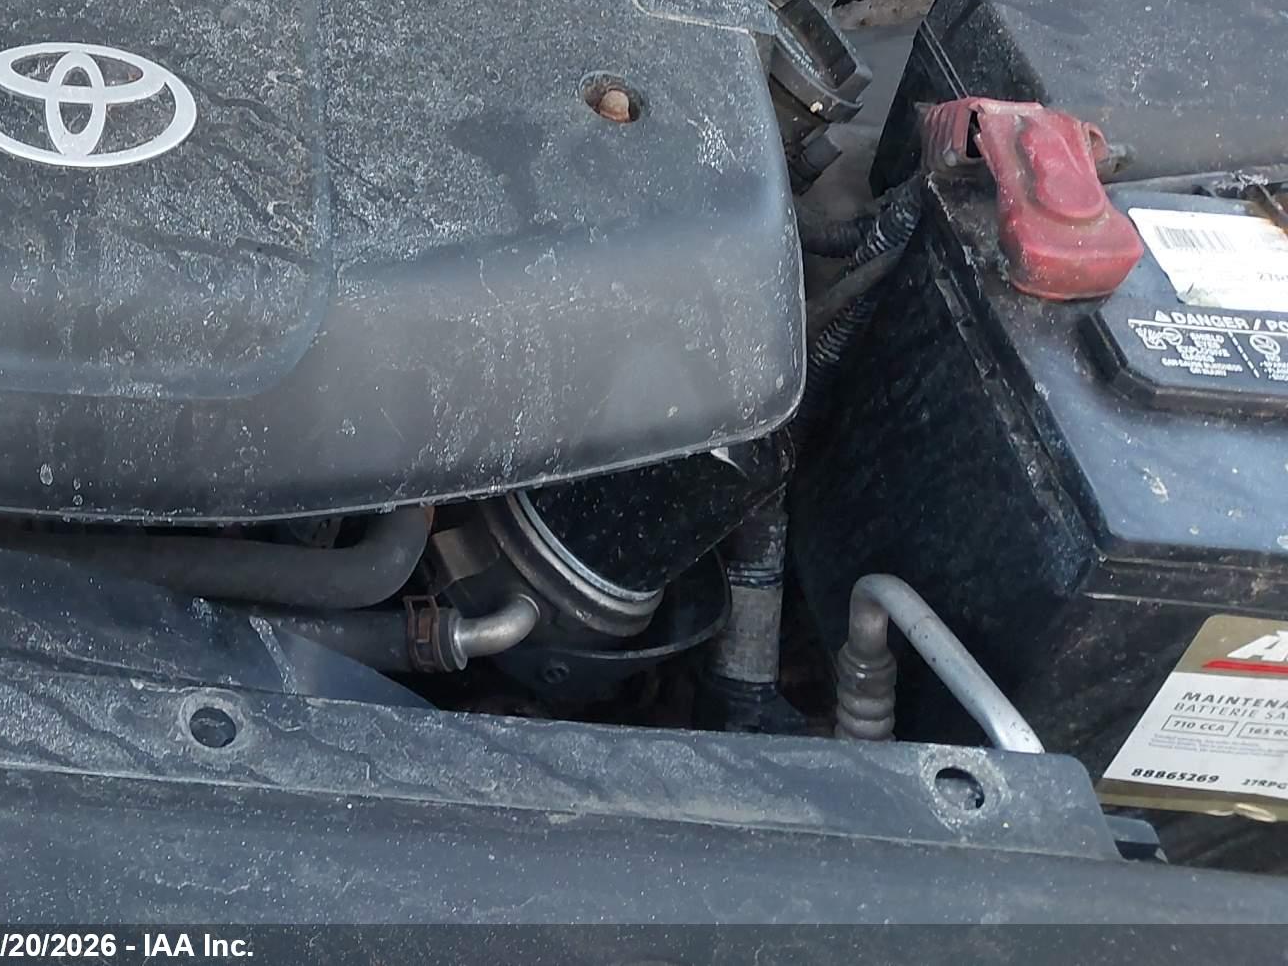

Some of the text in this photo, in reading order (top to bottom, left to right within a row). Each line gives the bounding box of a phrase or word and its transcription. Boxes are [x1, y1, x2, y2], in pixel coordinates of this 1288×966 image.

[1171, 312, 1249, 330] DANGER
[1182, 691, 1288, 709] MAINTENA
[1173, 702, 1259, 719] BATTERIE
[1173, 720, 1197, 729] 710
[1200, 722, 1225, 732] CCA
[1130, 768, 1220, 783] 88865269
